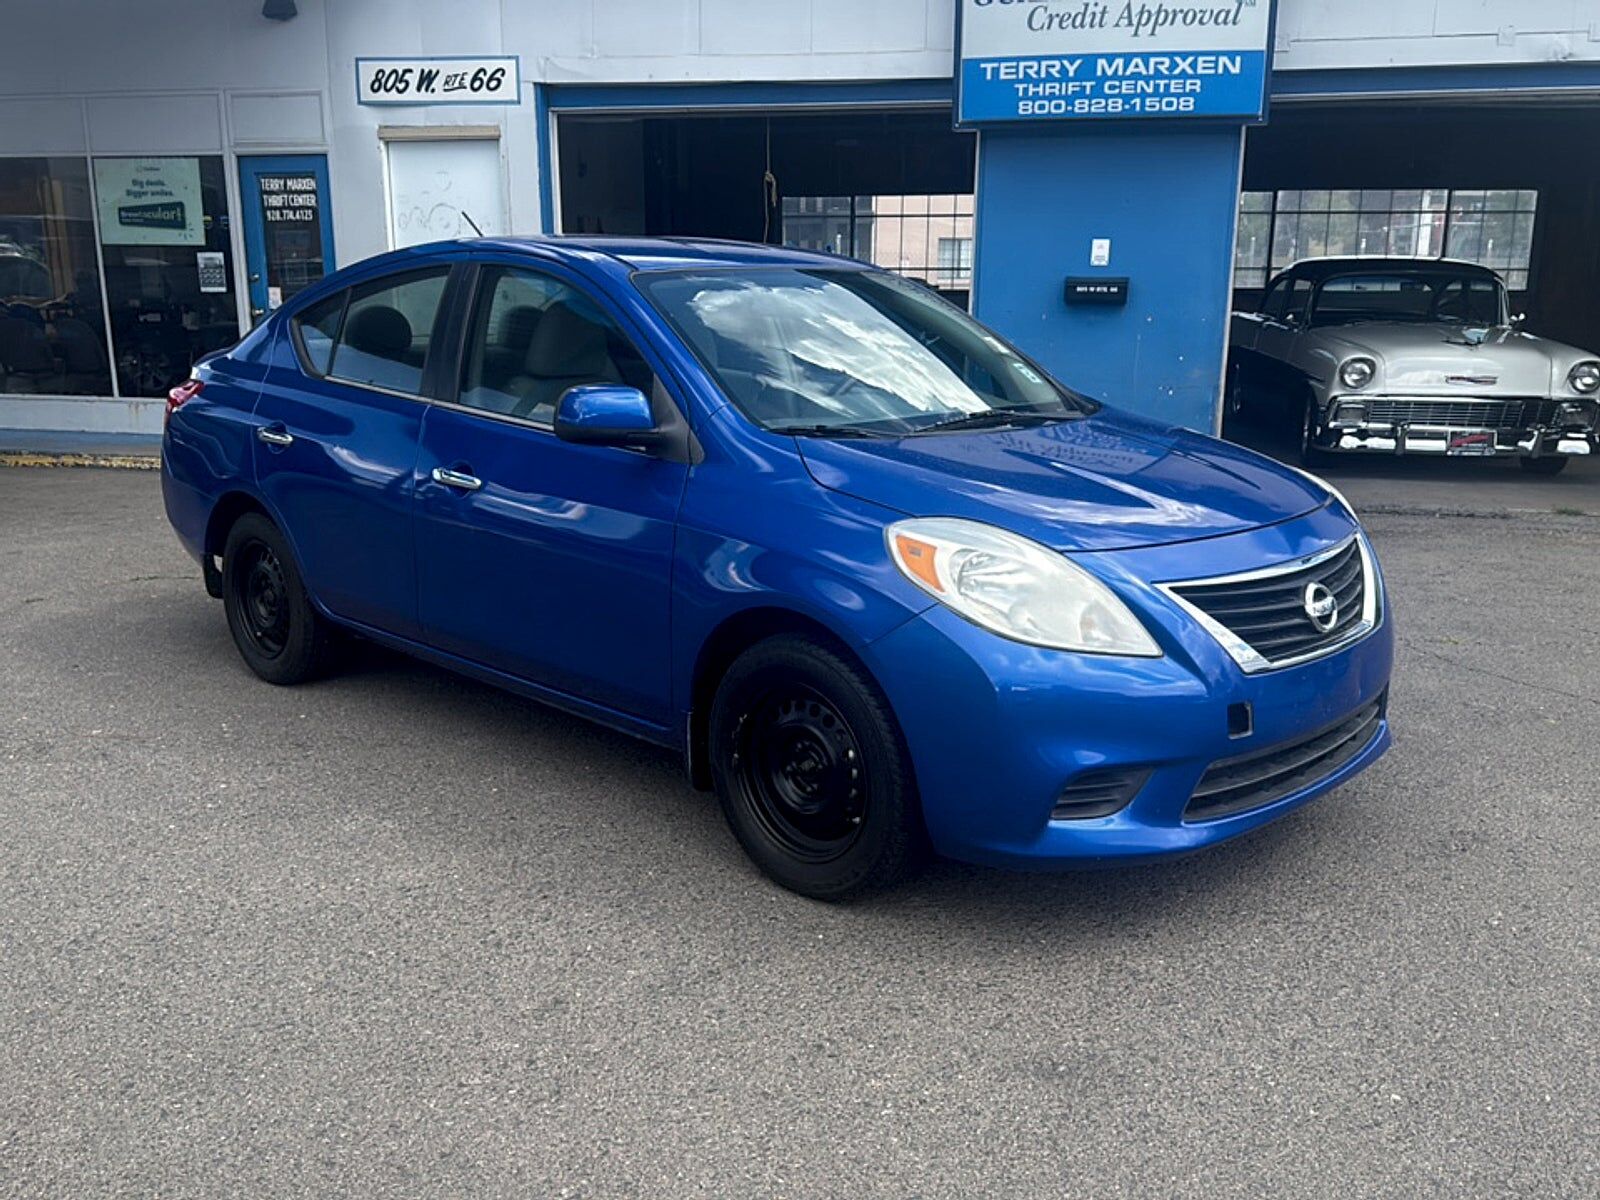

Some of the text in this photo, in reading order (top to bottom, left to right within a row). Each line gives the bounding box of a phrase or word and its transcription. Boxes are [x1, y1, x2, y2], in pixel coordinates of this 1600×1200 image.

[1027, 0, 1241, 37] Credit Approval
[980, 56, 1241, 80] TERRY MARXEN
[370, 67, 505, 94] 805 W. RTE 66
[1014, 79, 1201, 97] THRIFT CENTER
[1018, 97, 1195, 115] 800-828-1508
[261, 178, 285, 191] TERRY
[263, 194, 317, 207] THRIFT CENTER
